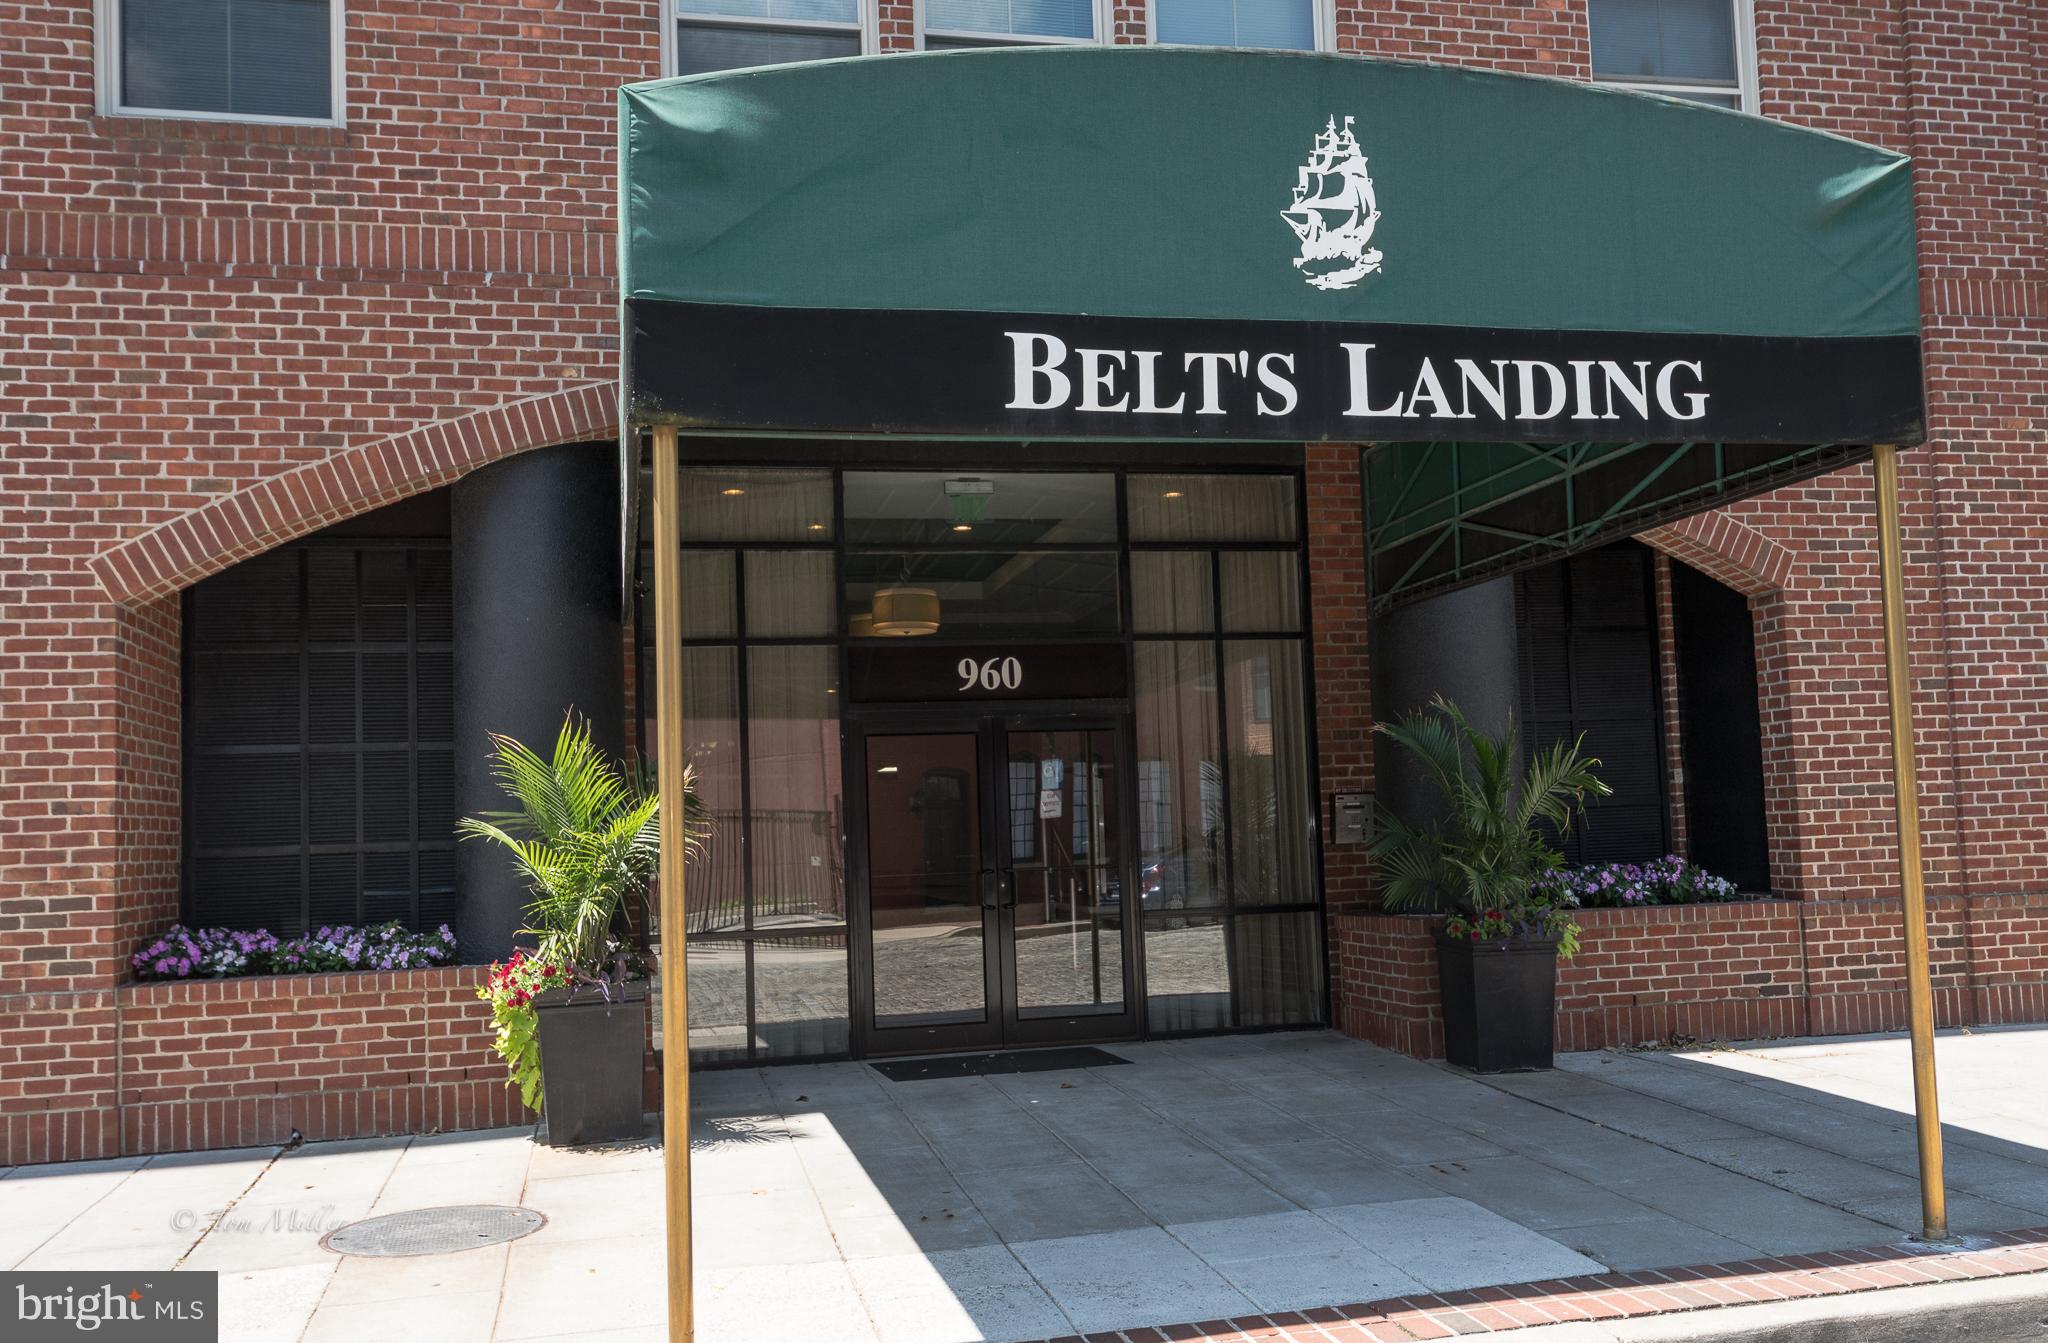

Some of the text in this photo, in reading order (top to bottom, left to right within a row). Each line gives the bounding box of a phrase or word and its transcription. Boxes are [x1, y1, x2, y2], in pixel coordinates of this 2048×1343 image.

[1003, 331, 1710, 421] BELT'S LANDING
[957, 655, 1023, 692] 960
